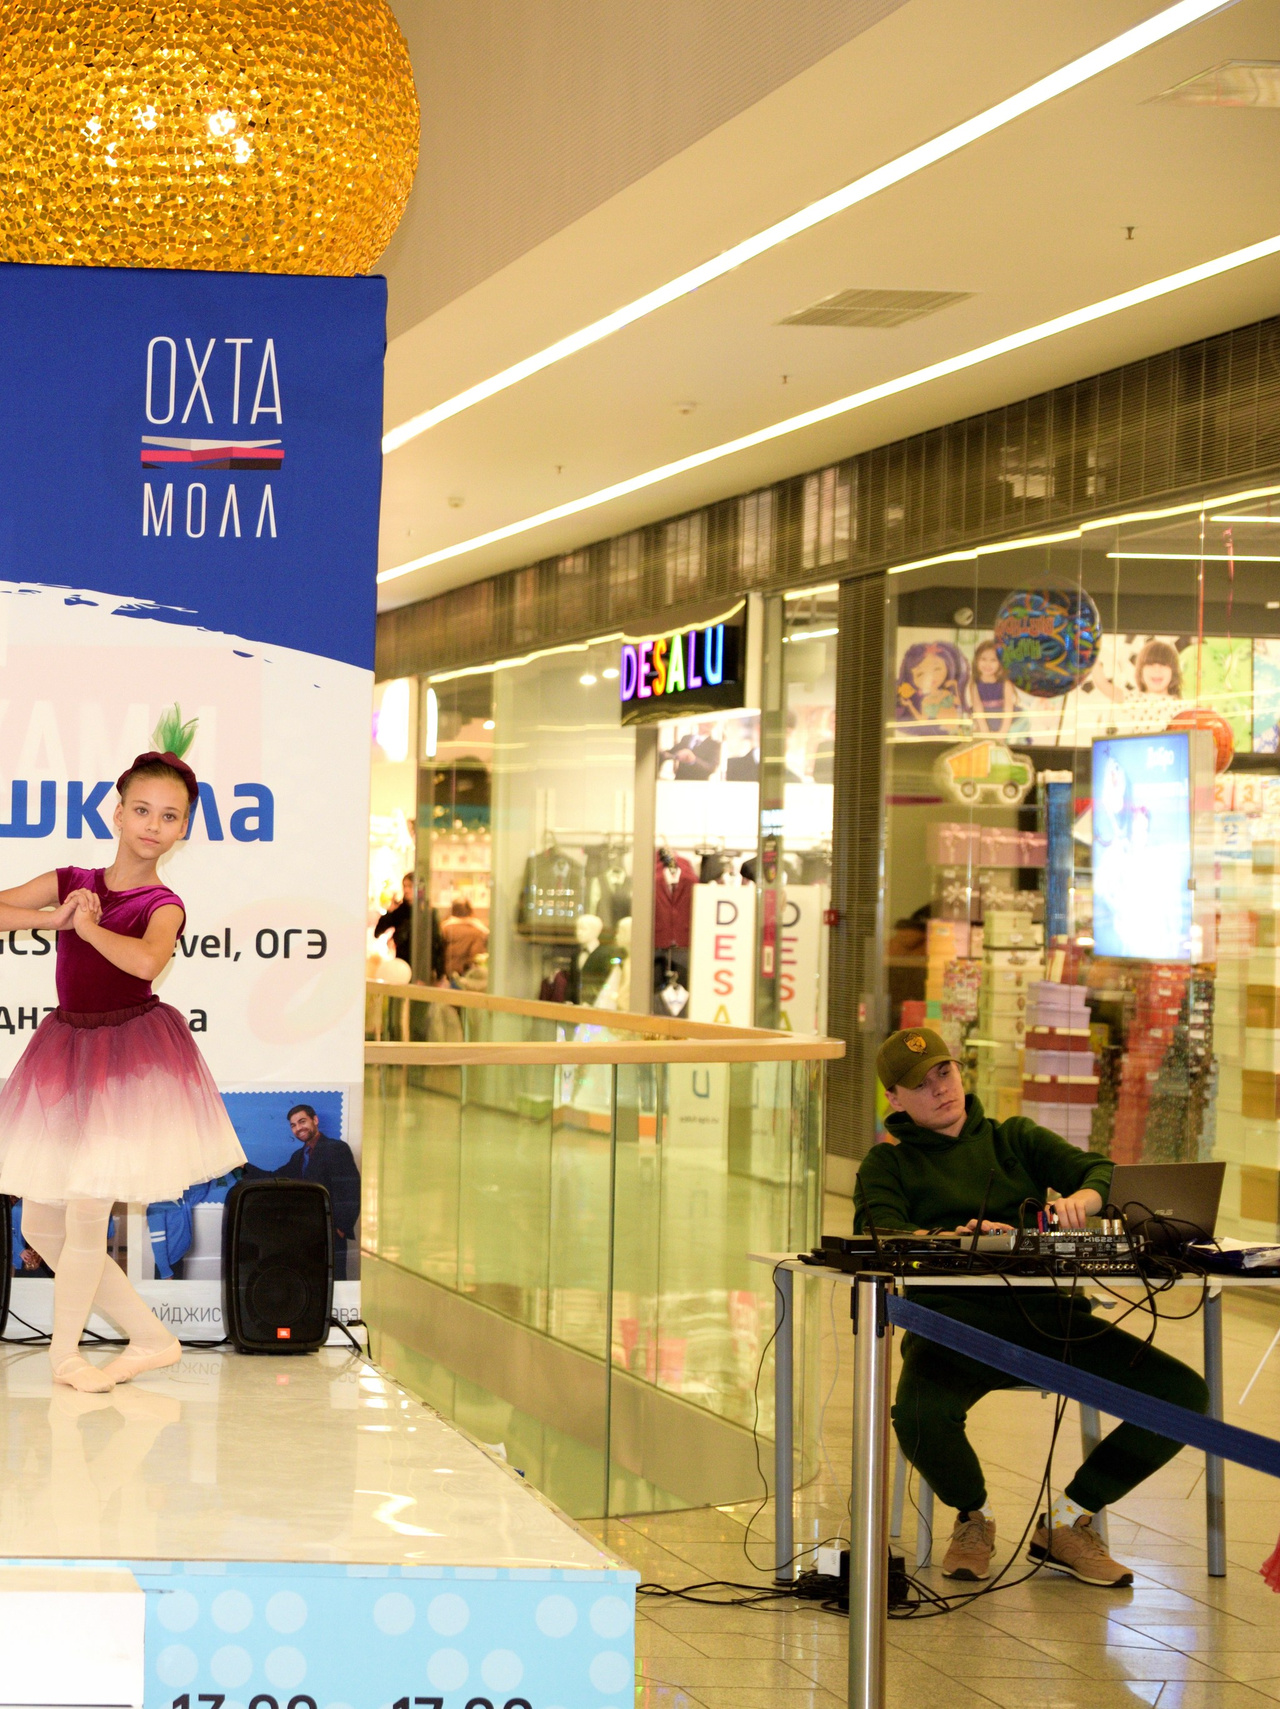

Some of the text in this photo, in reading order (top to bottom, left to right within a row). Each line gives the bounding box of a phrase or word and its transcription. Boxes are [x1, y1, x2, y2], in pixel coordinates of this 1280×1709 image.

[145, 336, 283, 425] ОХТА
[142, 482, 277, 539] МОЛЛ
[620, 623, 724, 702] DESALU
[255, 928, 327, 960] ОГЭ
